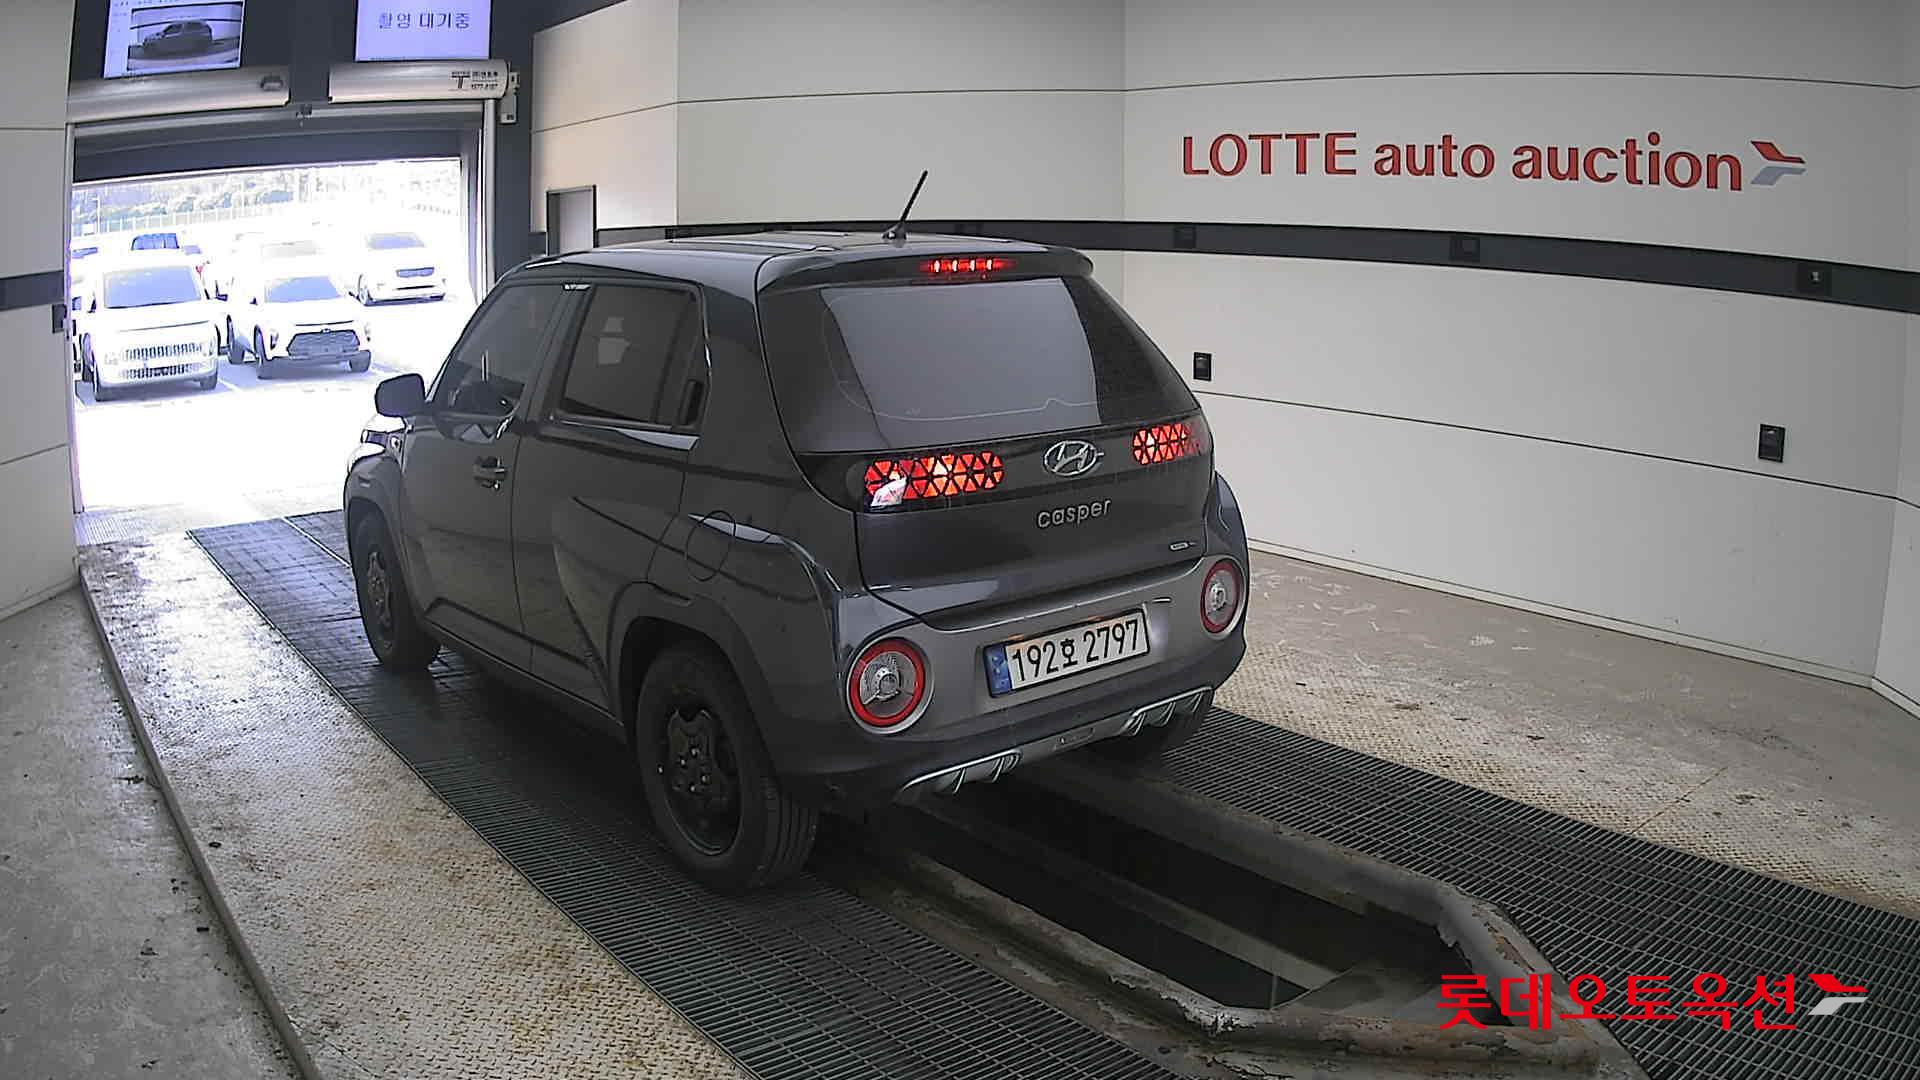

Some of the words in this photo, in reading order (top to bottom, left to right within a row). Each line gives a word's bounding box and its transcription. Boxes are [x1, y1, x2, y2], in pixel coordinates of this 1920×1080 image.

[419, 12, 470, 29] 대기중
[1182, 132, 1358, 176] LOTTE
[1374, 134, 1496, 179] auto
[1512, 131, 1743, 191] auction
[1037, 500, 1111, 528] casper
[1012, 638, 1078, 682] 192호
[1083, 619, 1138, 663] 2797
